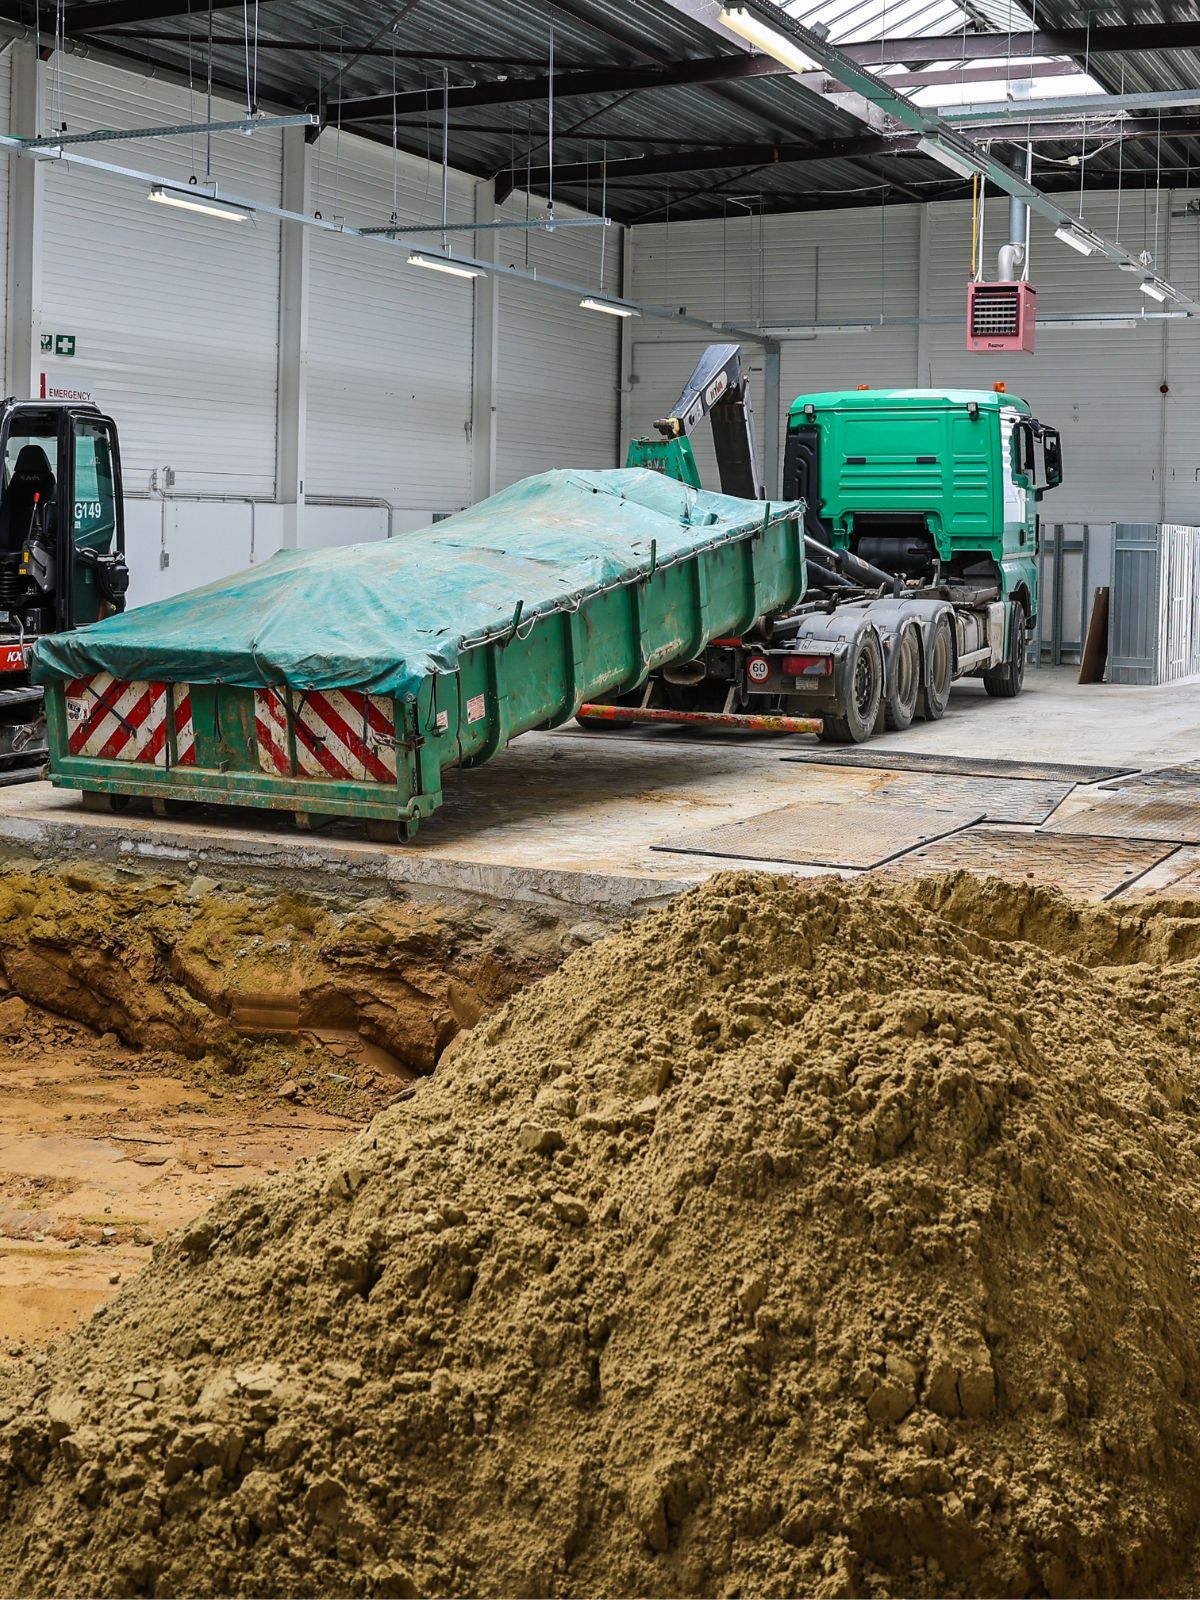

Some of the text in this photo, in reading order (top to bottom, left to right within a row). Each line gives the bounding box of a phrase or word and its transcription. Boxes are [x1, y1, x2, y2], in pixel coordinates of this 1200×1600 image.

[49, 388, 91, 401] EMERGENCY
[74, 502, 101, 519] G149
[752, 663, 766, 673] 60
